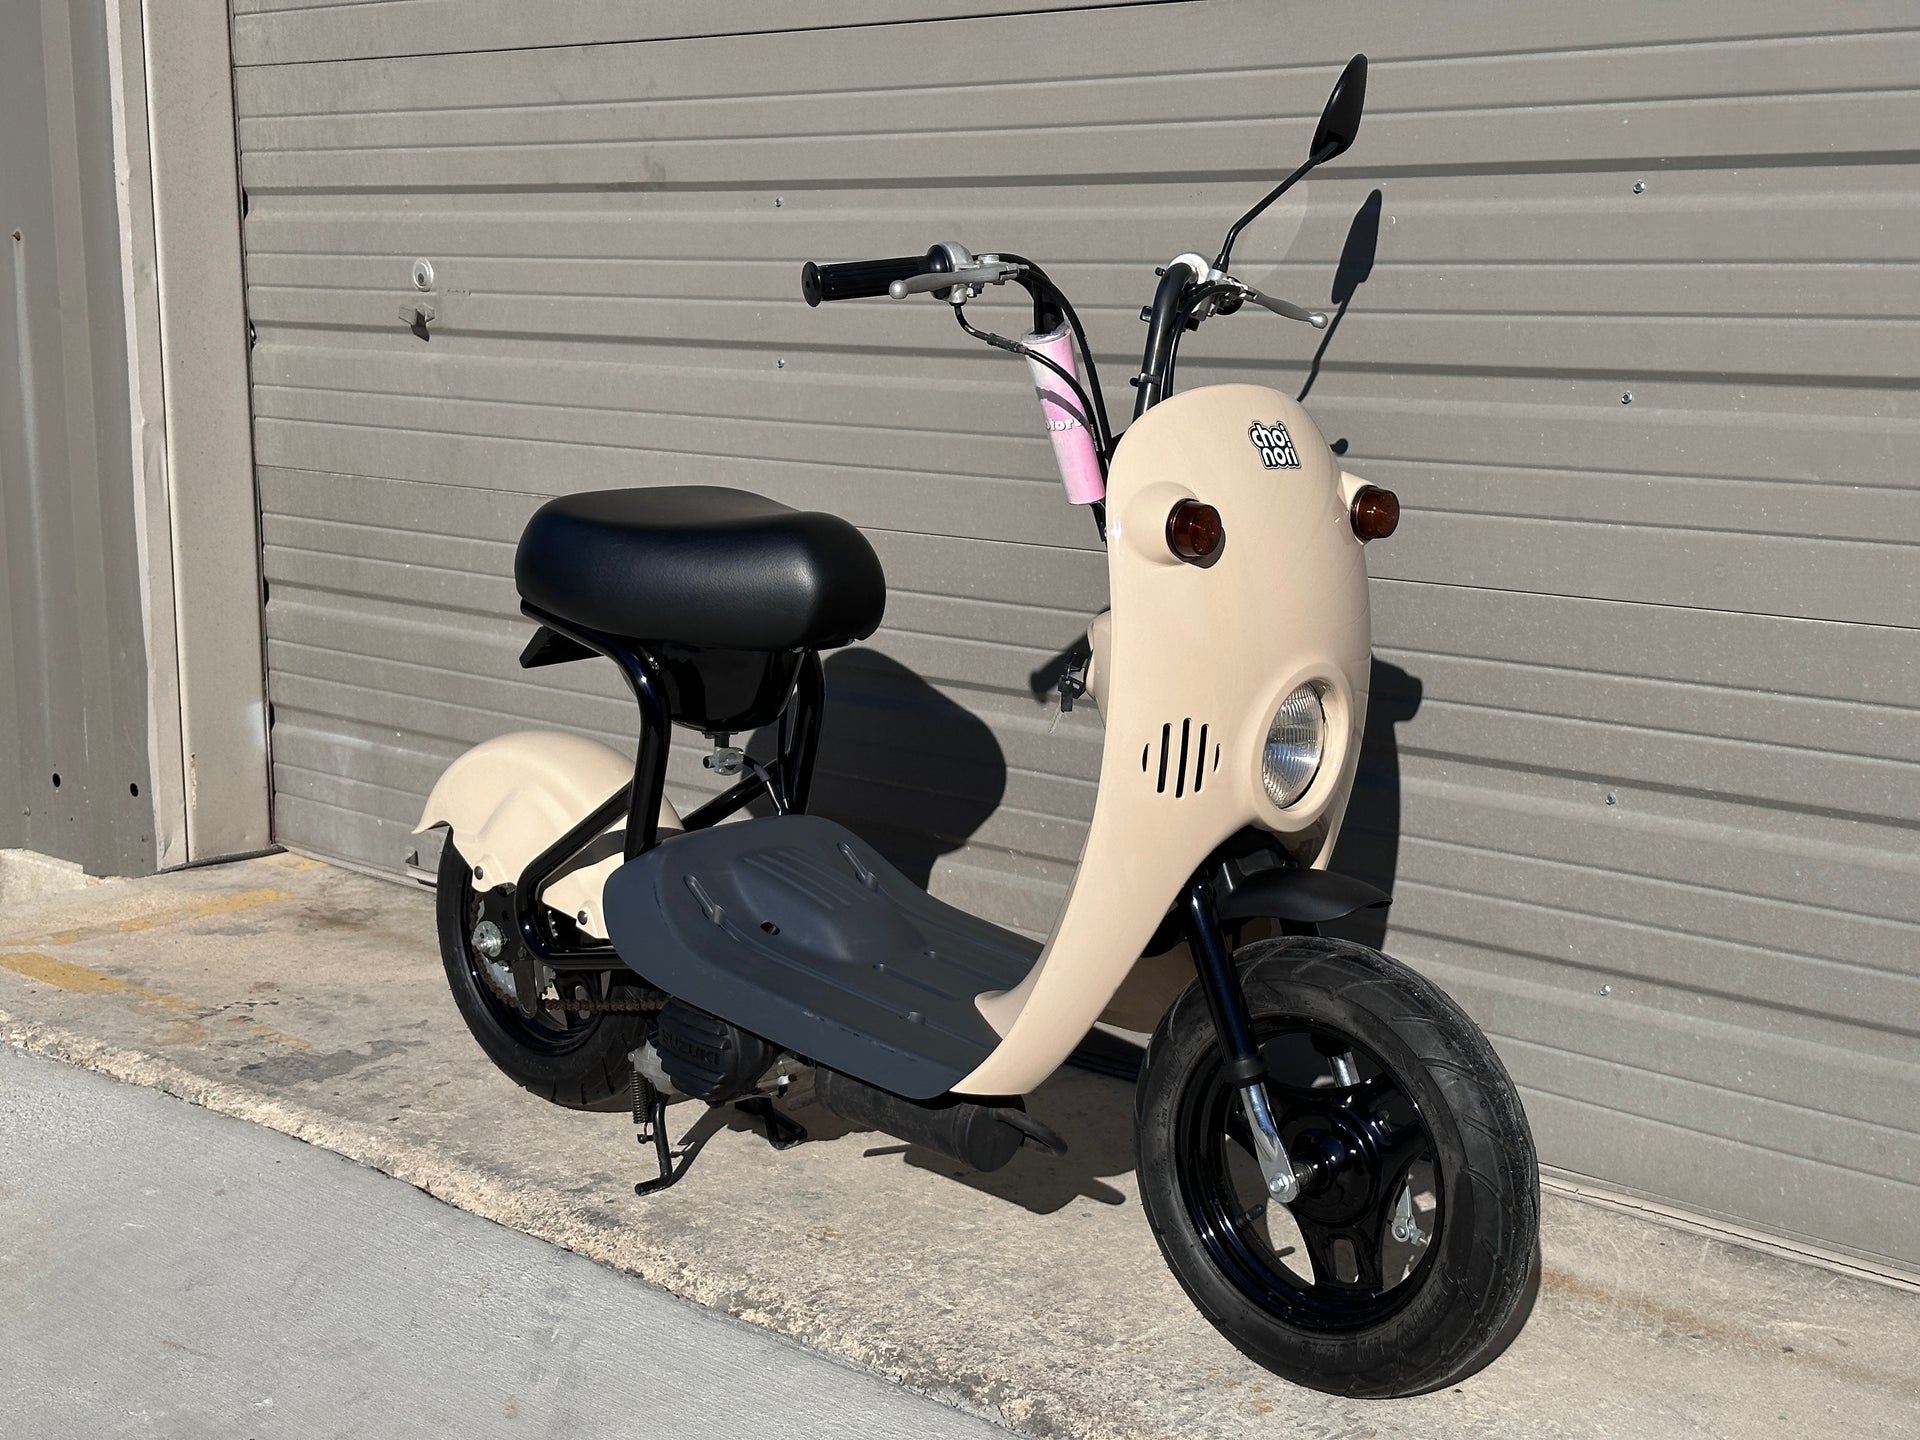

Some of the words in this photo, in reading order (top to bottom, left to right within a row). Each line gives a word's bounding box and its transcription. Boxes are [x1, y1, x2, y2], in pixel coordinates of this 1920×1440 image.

[1250, 423, 1291, 448] choi
[1261, 441, 1300, 467] nori
[660, 1028, 722, 1066] SUZUKI
